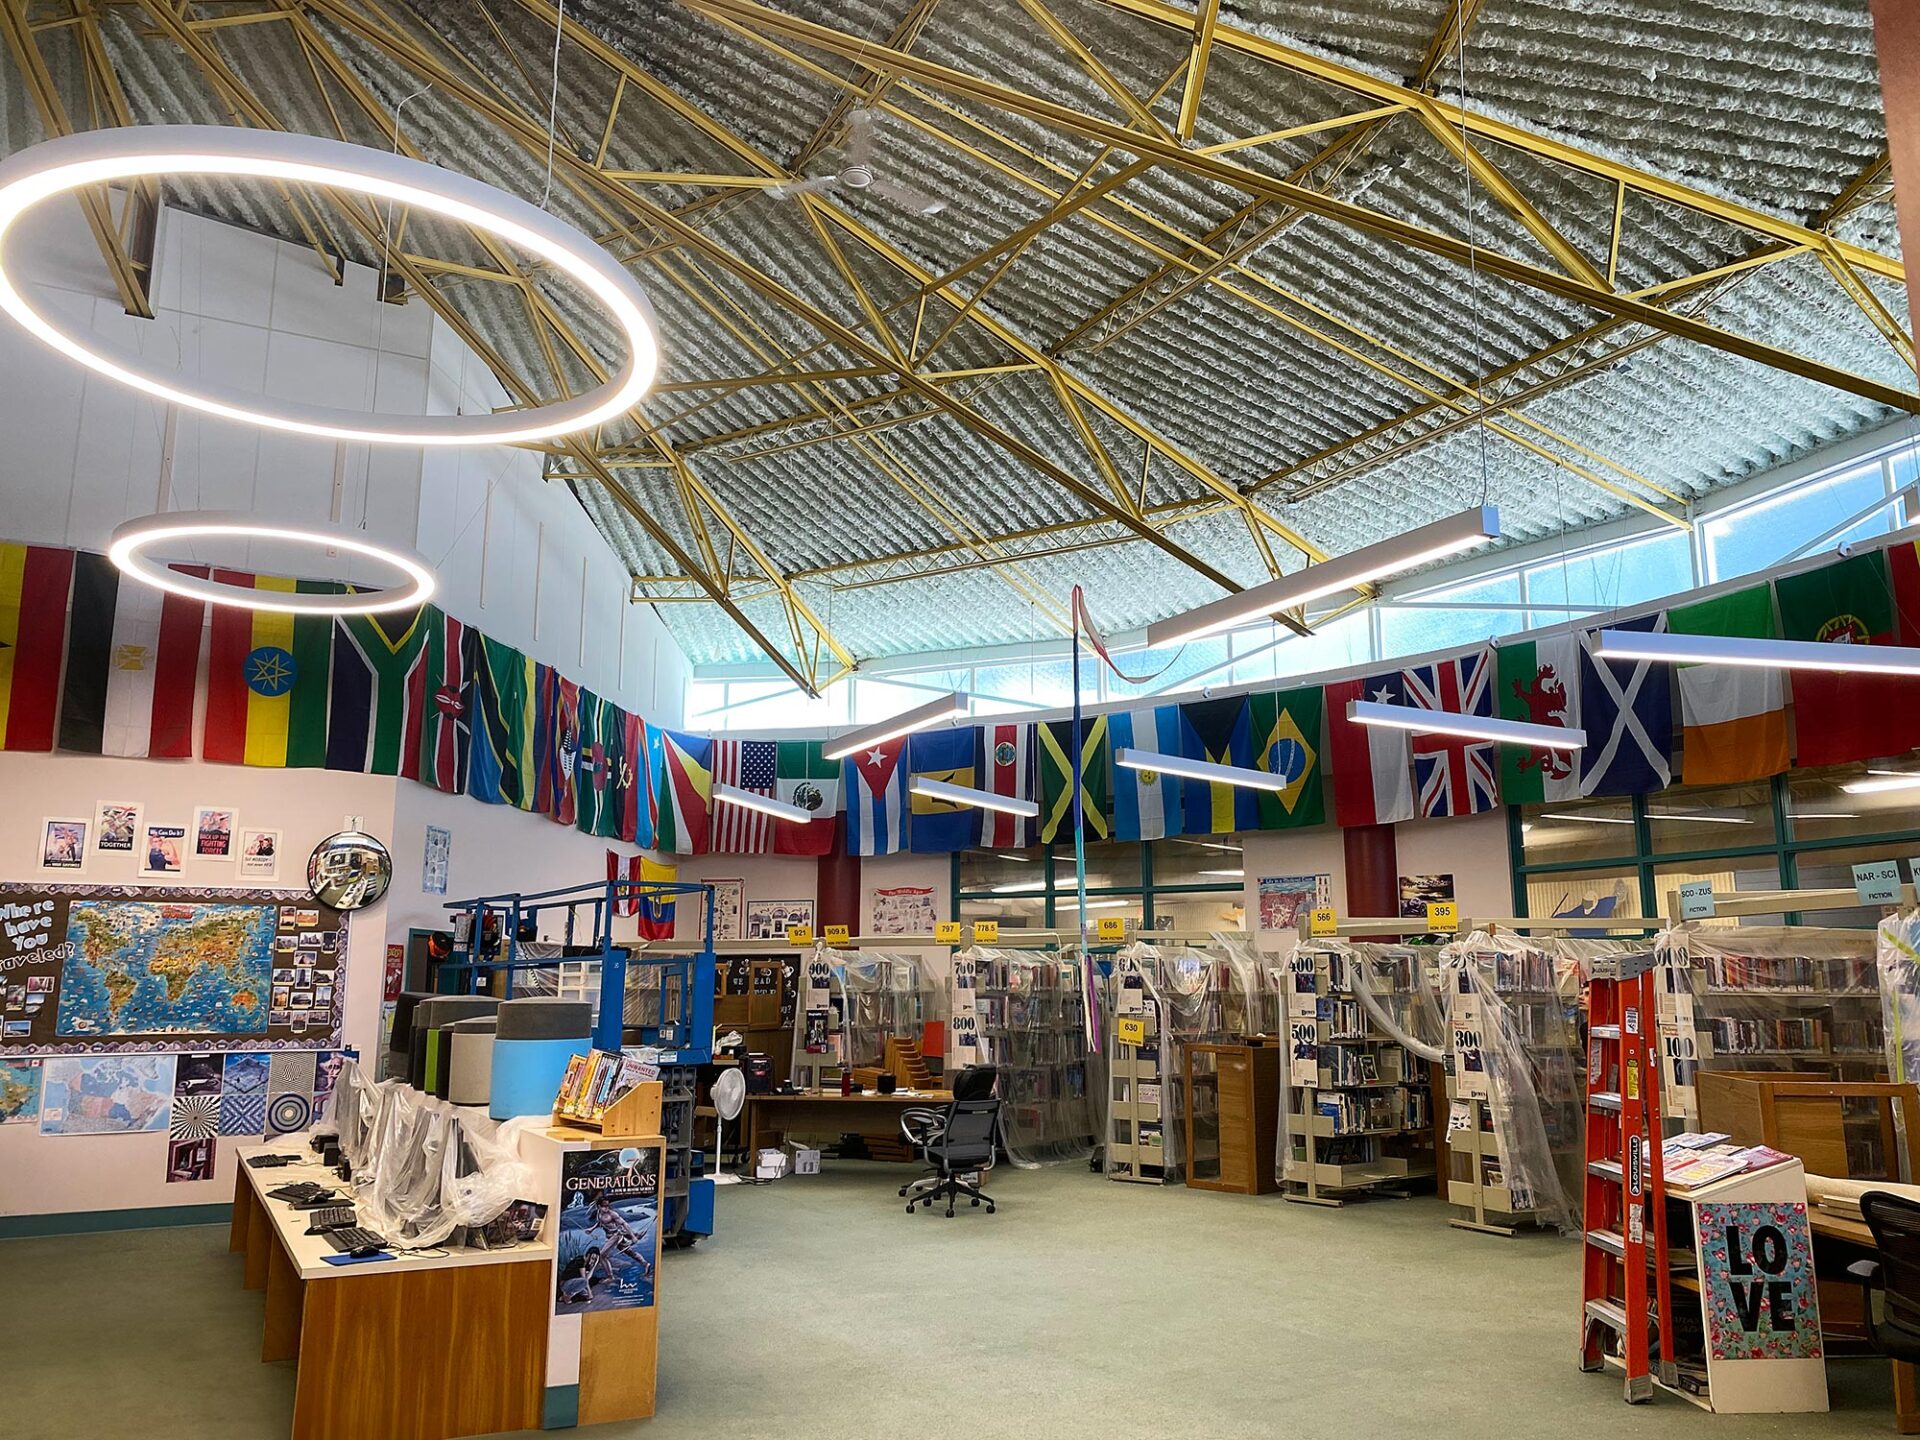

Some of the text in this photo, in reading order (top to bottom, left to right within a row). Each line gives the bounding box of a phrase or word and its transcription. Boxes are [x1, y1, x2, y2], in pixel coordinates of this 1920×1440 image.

[100, 841, 131, 849] TOGETHER
[201, 840, 226, 848] FIGHTING
[1856, 871, 1876, 882] NAR
[1880, 869, 1897, 879] SCI
[1698, 887, 1712, 896] ZUS
[1868, 891, 1893, 900] FICTION
[0, 900, 55, 920] Where
[1434, 906, 1451, 916] 395
[1689, 905, 1707, 913] FICTION
[1317, 912, 1331, 922] 566
[4, 916, 52, 937] have
[794, 929, 806, 937] 921
[827, 927, 846, 935] 909.8
[941, 924, 954, 933] 797
[808, 962, 829, 975] 900
[1288, 956, 1314, 973] 400
[952, 1016, 975, 1030] 800
[1125, 1022, 1138, 1032] 630
[1292, 1024, 1316, 1040] 500
[1455, 1030, 1483, 1048] 300
[1664, 1037, 1695, 1058] 100
[625, 1061, 656, 1076] UNWANTED
[565, 1174, 657, 1191] GENERATIONS
[1725, 1225, 1788, 1276] LO
[1728, 1281, 1796, 1332] VE
